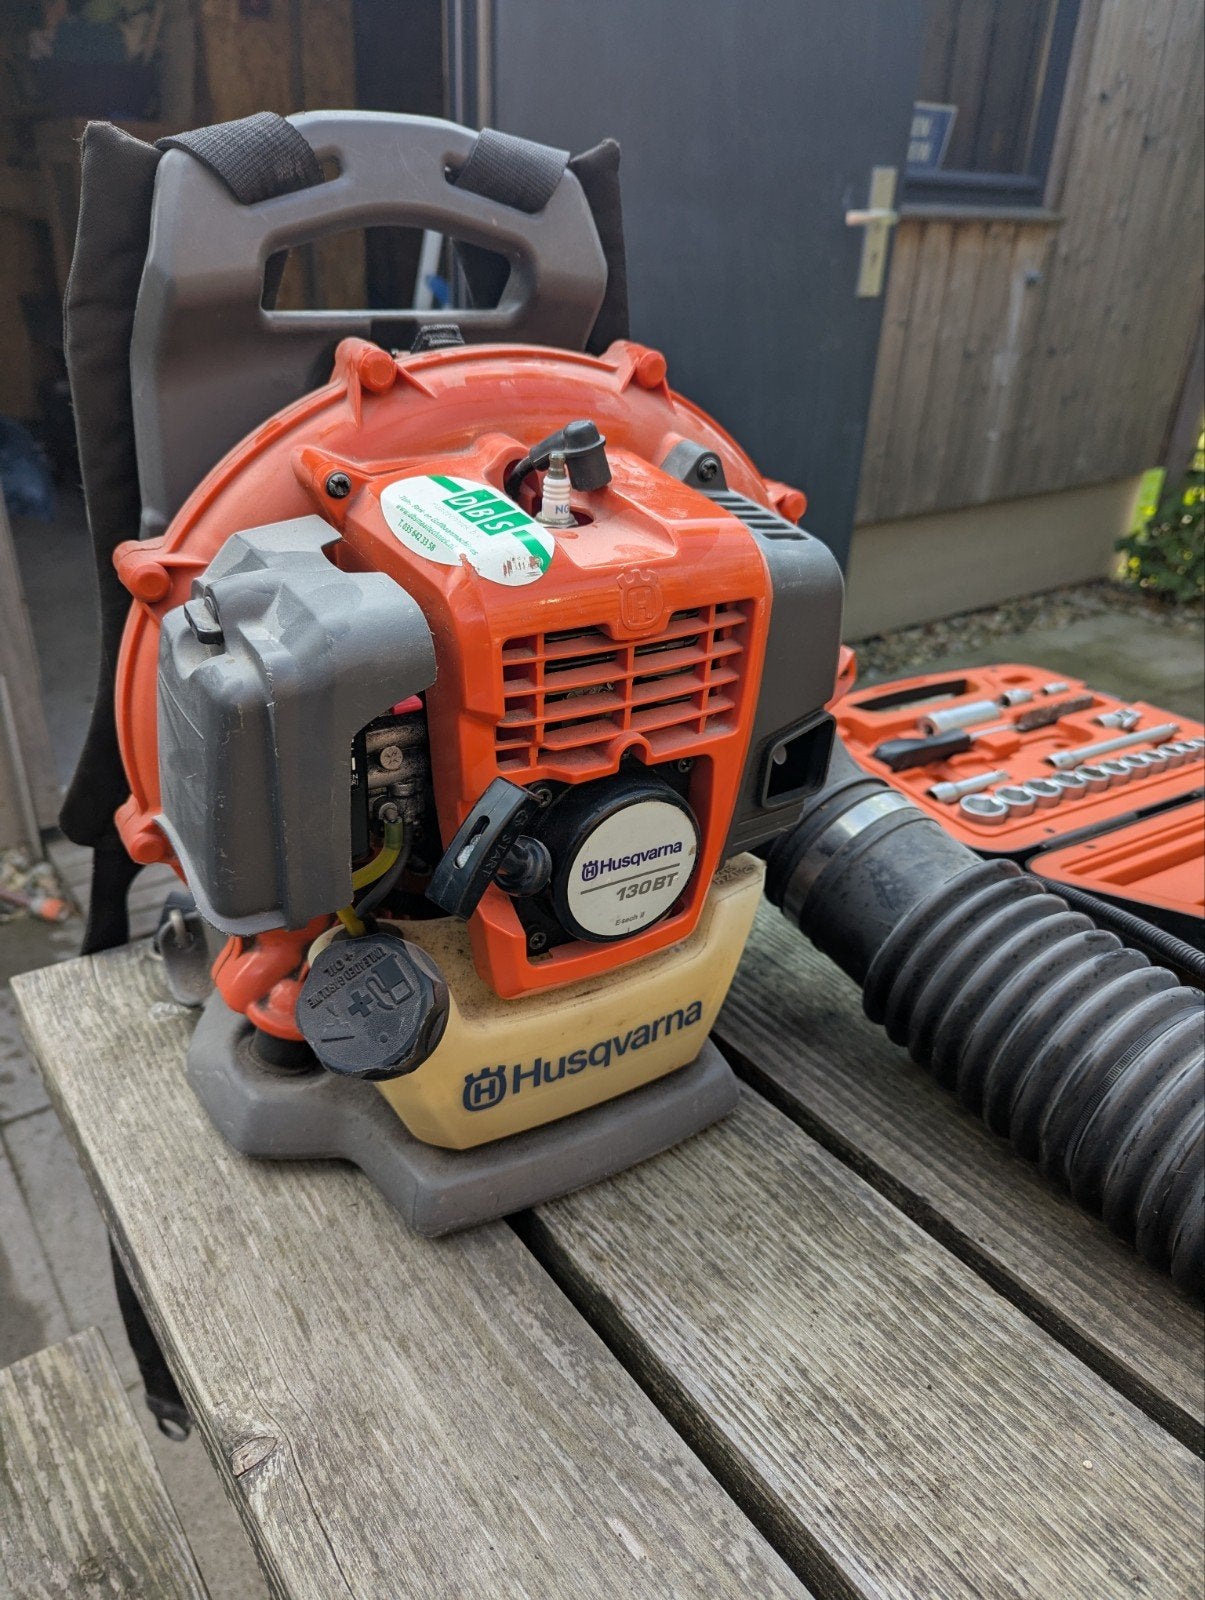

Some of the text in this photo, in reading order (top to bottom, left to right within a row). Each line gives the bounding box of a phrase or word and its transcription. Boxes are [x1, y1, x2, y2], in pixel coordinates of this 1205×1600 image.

[447, 495, 517, 532] DBS
[482, 834, 511, 878] START
[600, 841, 683, 875] Husqvarna
[323, 959, 345, 978] OIL
[512, 1000, 703, 1094] Husqvarna
